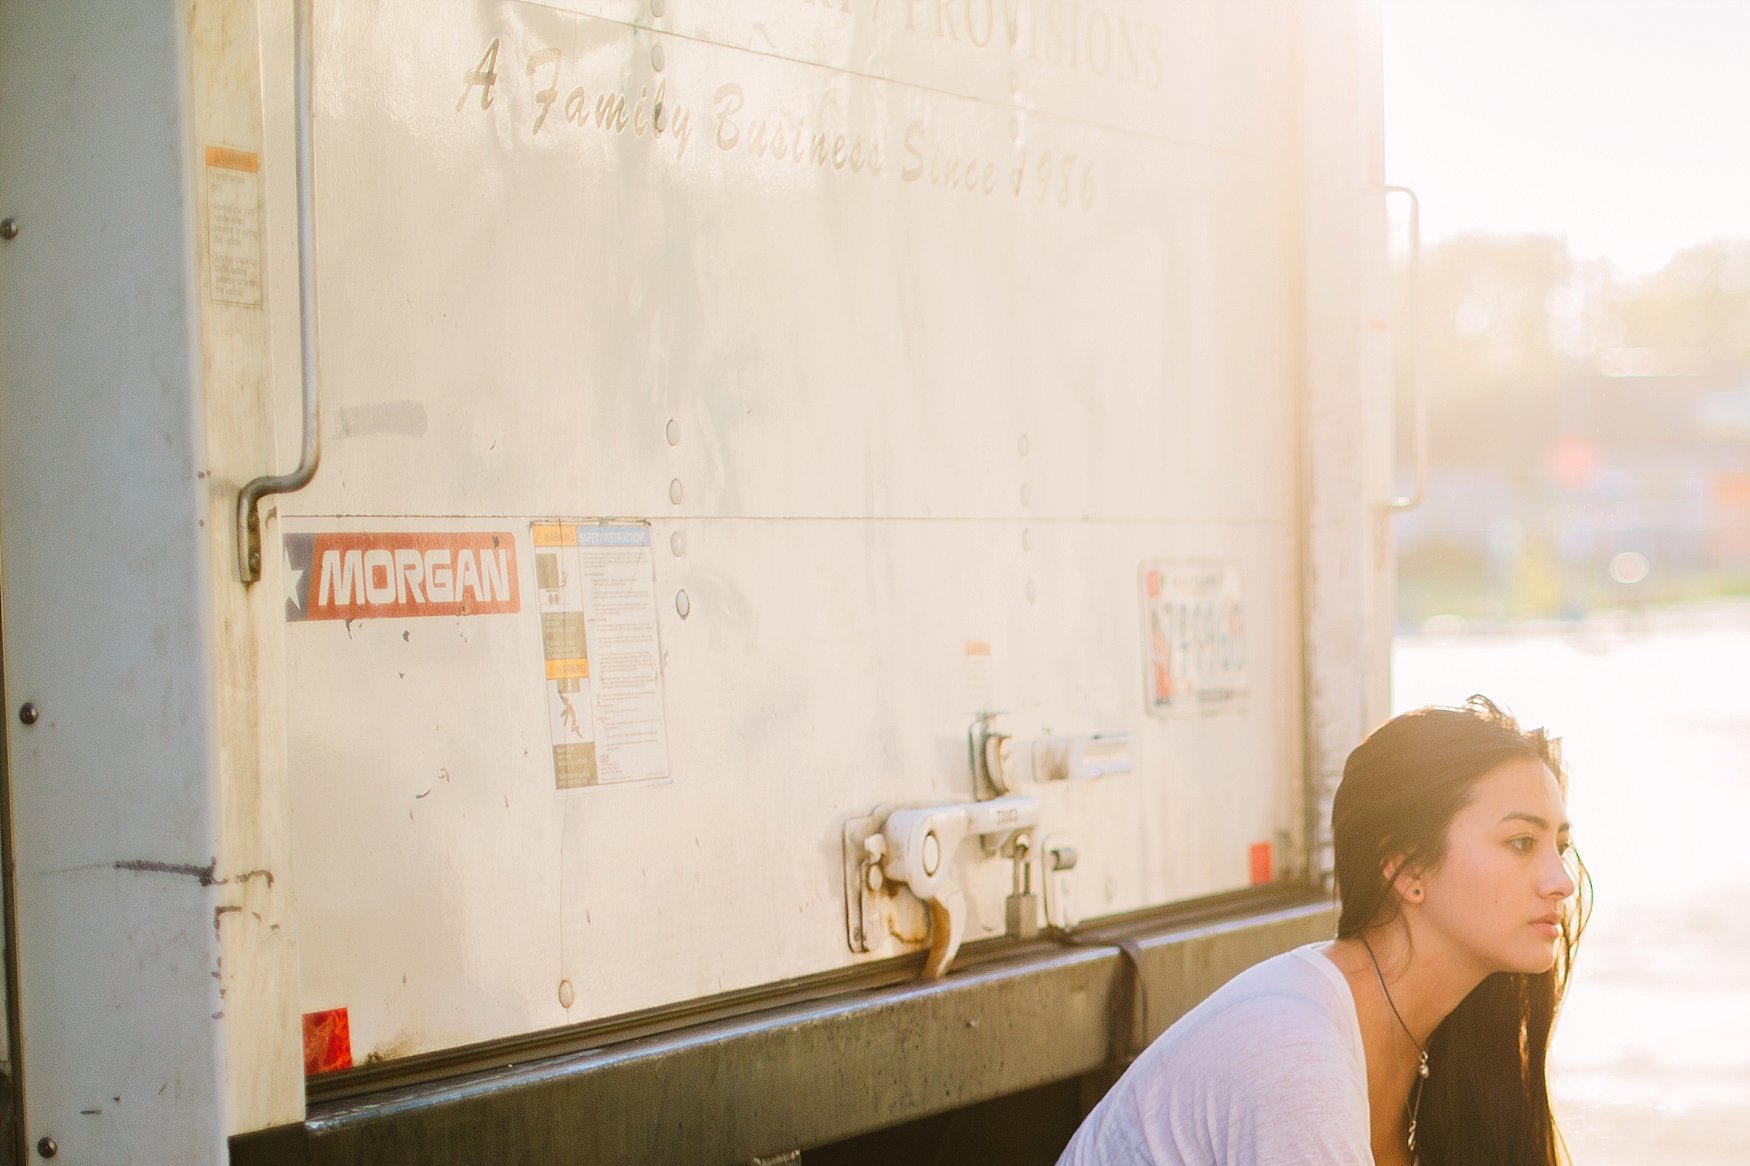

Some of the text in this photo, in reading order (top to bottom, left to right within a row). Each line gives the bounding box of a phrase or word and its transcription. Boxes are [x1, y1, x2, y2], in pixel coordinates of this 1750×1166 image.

[455, 37, 499, 114] A
[525, 46, 692, 164] Family
[712, 82, 883, 177] Business
[900, 120, 995, 196] Since
[318, 549, 510, 606] MORGAN
